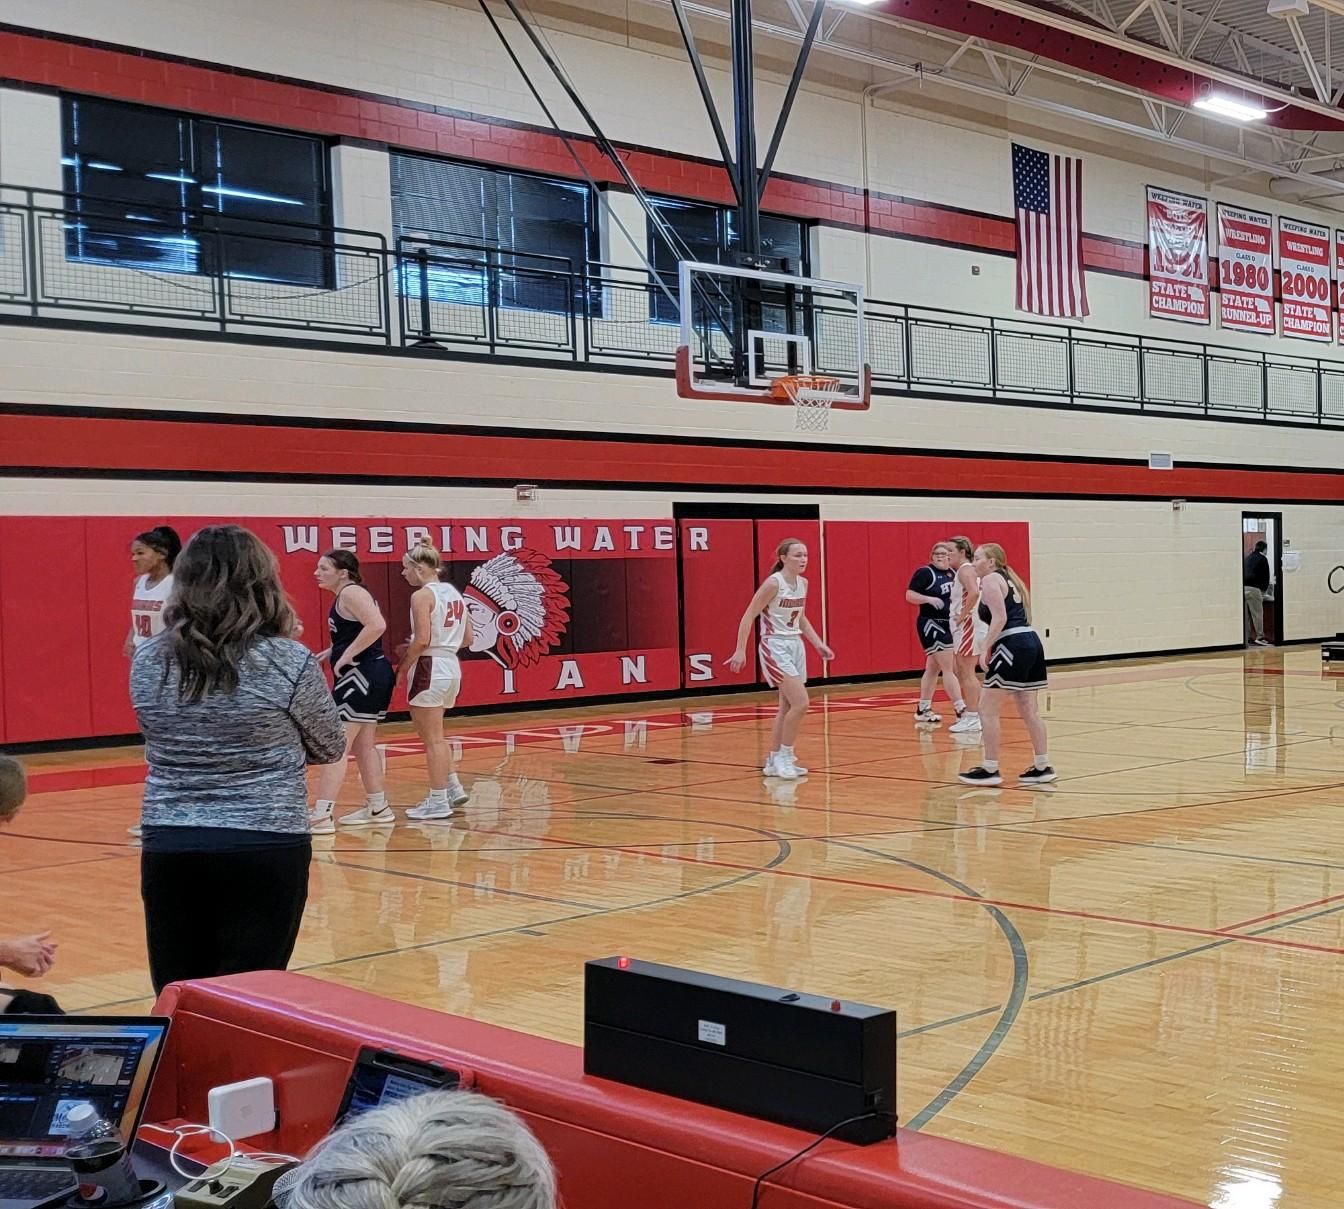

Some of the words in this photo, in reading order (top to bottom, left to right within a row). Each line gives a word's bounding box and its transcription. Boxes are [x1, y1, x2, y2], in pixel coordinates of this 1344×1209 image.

[1249, 215, 1268, 225] WATER
[1225, 228, 1266, 245] WRESTLING
[1283, 222, 1307, 233] WEEPING
[1309, 229, 1326, 237] WATER
[1236, 252, 1251, 260] CLASS
[1286, 240, 1324, 257] WRESTLING
[1221, 259, 1270, 291] 1980
[1296, 264, 1310, 272] CLASS
[1152, 281, 1187, 298] STATE
[1282, 271, 1329, 302] 2000
[1152, 295, 1205, 315] CHAMPION
[1222, 293, 1254, 308] STATE
[1221, 306, 1272, 325] RUNNER-UP
[1283, 303, 1313, 318] STATE
[1283, 317, 1330, 334] CHAMPION
[277, 525, 524, 554] WEEPING
[552, 525, 710, 551] WATER
[443, 599, 465, 628] 24
[500, 653, 716, 694] IANS
